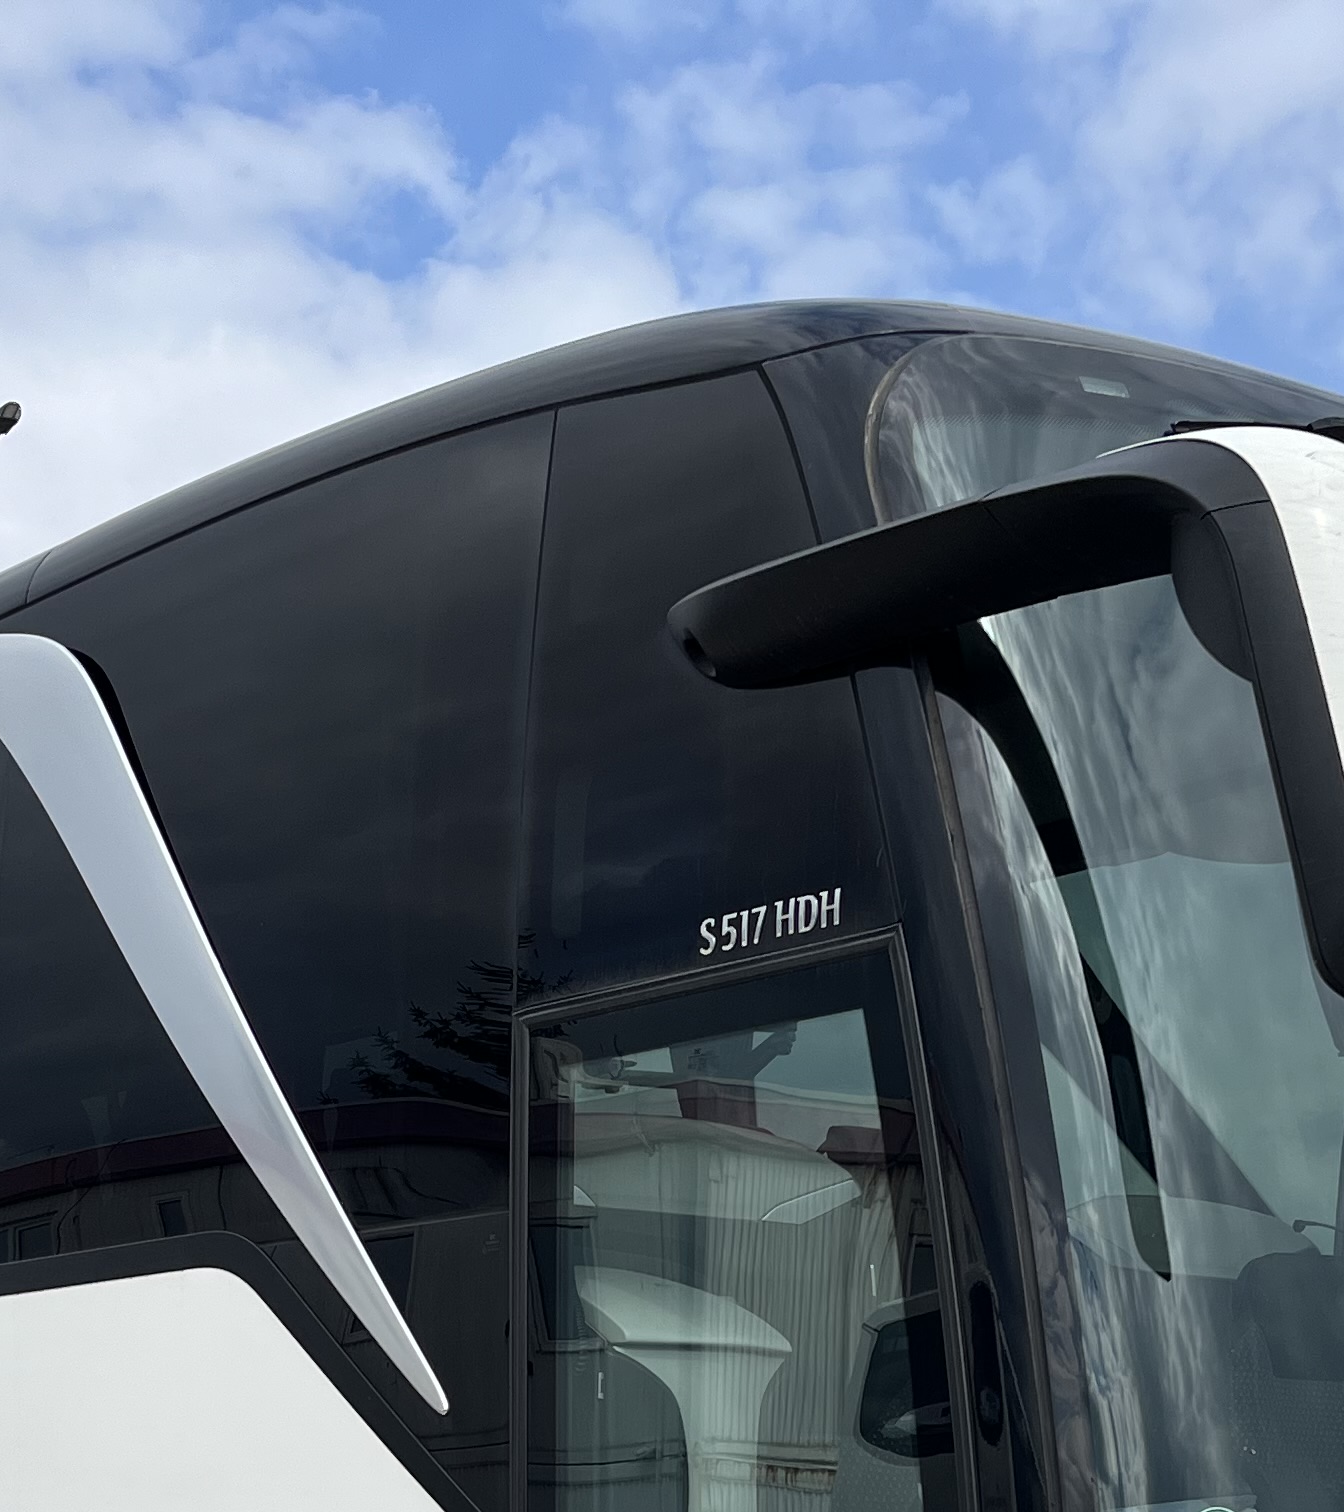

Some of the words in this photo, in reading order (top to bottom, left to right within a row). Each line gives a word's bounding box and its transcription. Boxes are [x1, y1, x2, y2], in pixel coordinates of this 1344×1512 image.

[699, 917, 717, 956] S
[721, 905, 767, 952] 517
[774, 887, 842, 938] HDH
